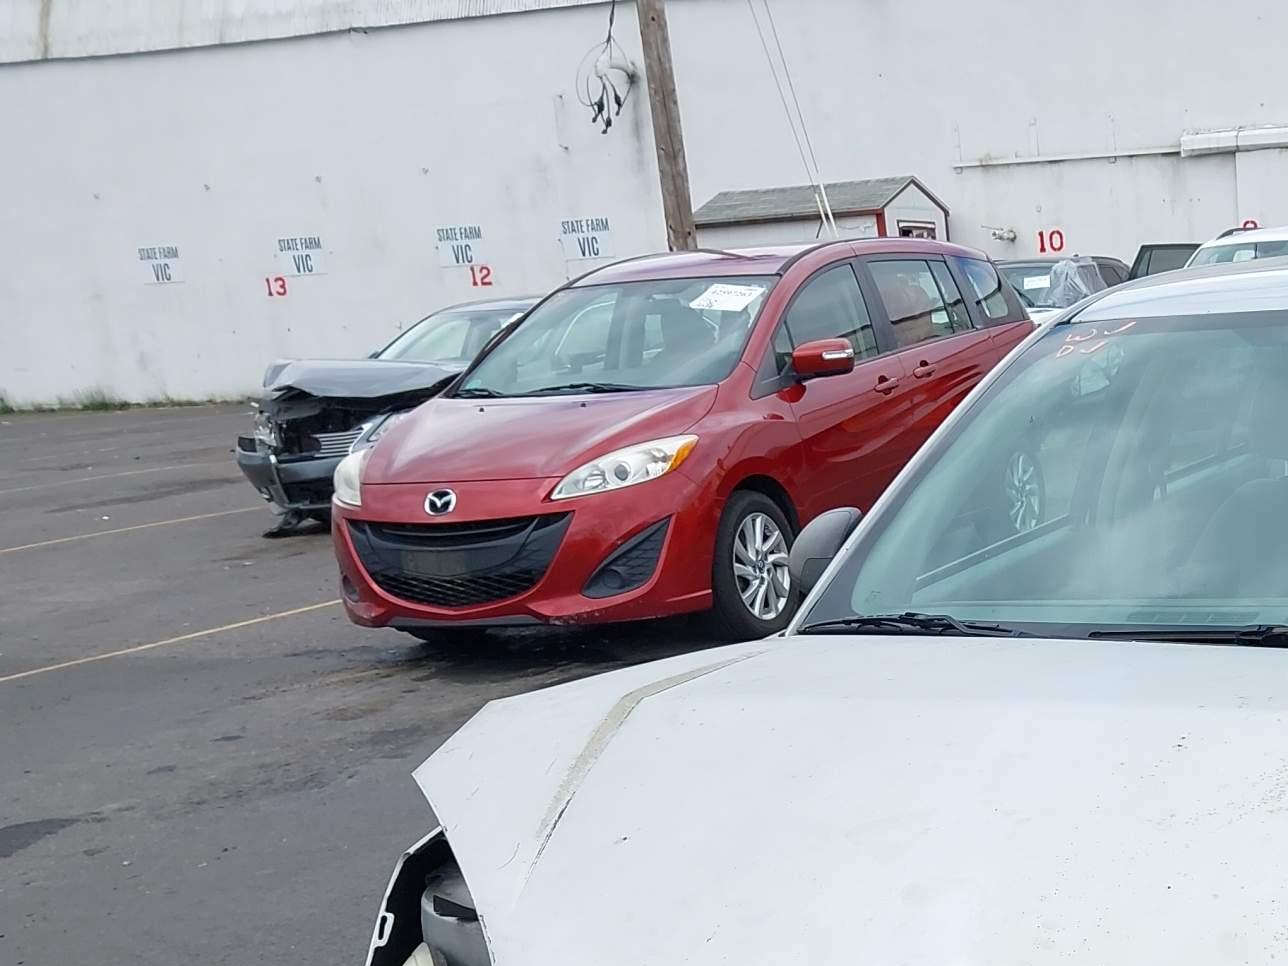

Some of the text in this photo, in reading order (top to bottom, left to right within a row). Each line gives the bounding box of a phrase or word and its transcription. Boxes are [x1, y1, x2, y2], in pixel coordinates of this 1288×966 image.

[437, 226, 482, 242] STATE FARM
[561, 218, 609, 235] STATE FARM
[278, 236, 322, 252] STATE FARM
[577, 236, 600, 257] VIC
[1038, 229, 1064, 252] 10
[138, 246, 179, 261] STATE FARM
[292, 253, 314, 274] VIC
[451, 243, 473, 264] VIC
[152, 263, 172, 282] VIC
[470, 266, 493, 286] 12
[265, 276, 288, 297] 13
